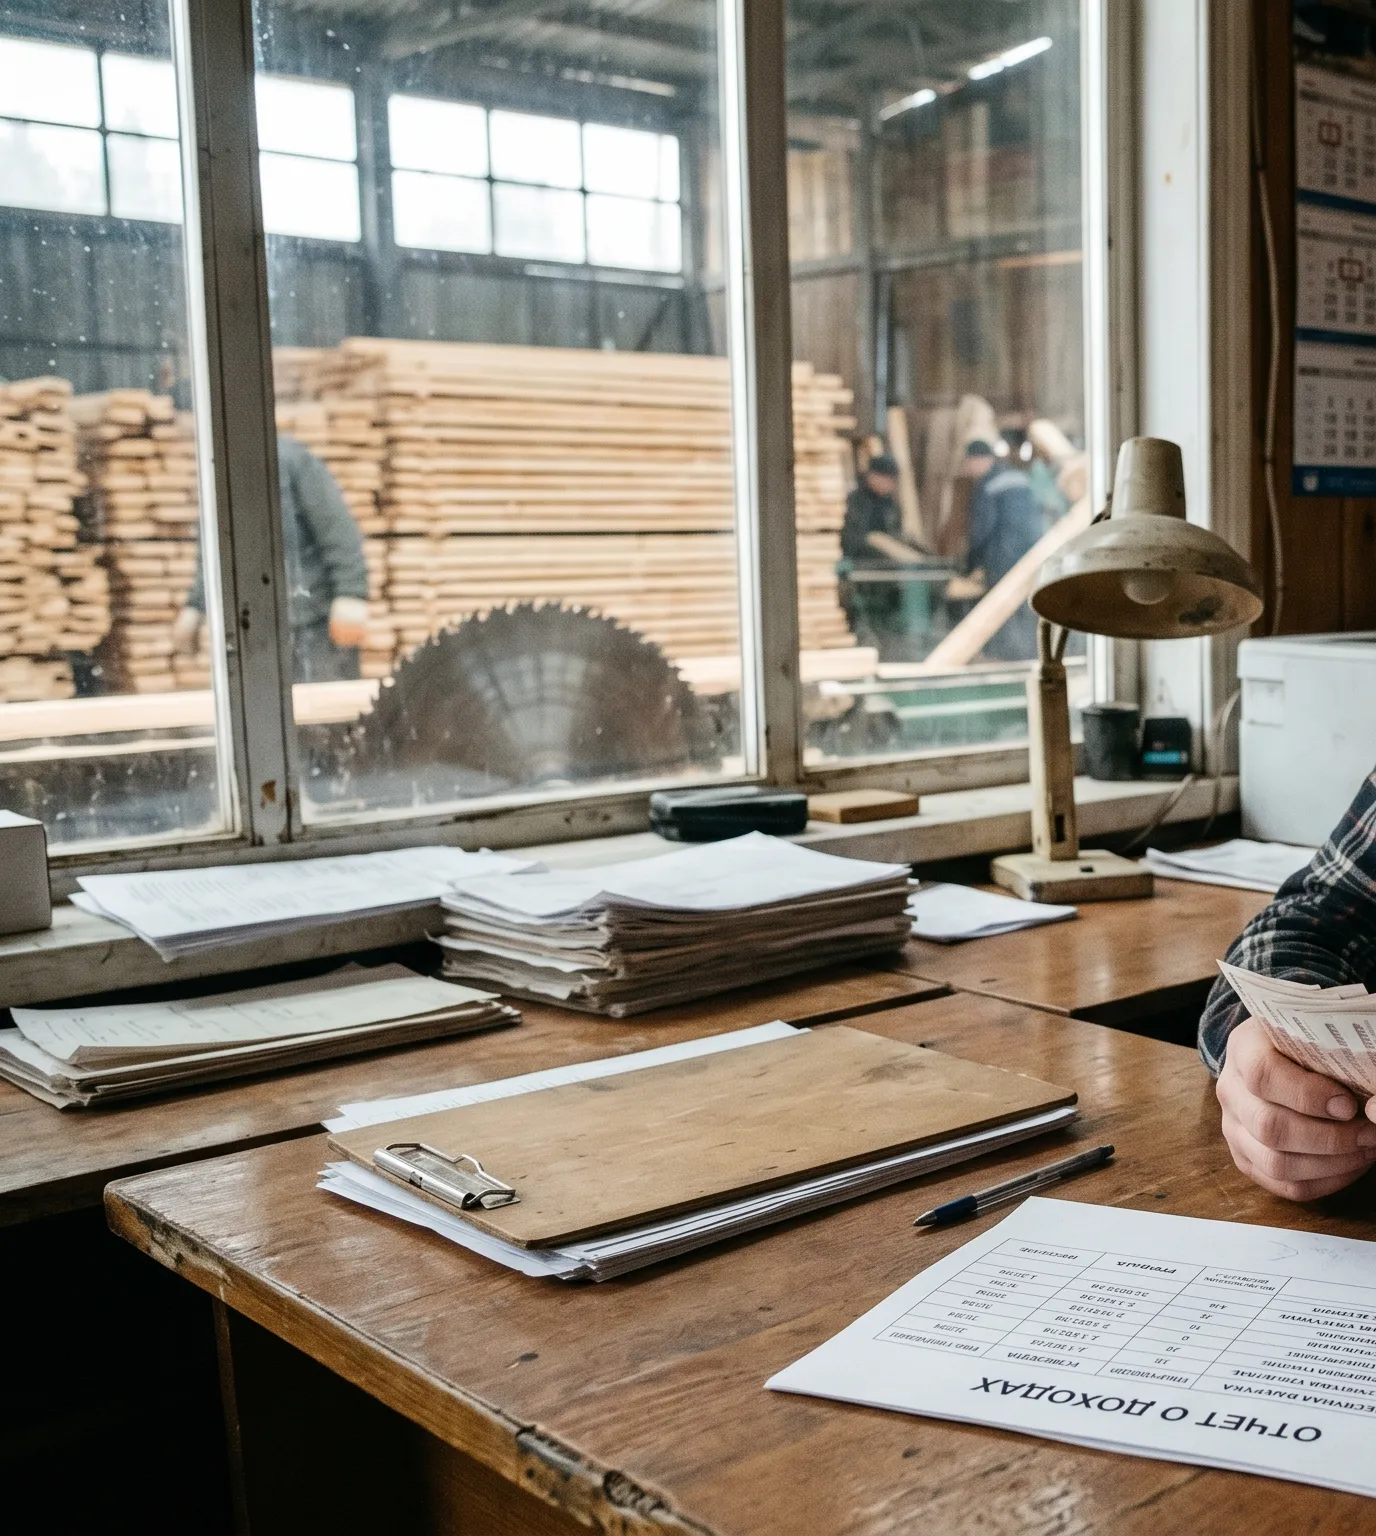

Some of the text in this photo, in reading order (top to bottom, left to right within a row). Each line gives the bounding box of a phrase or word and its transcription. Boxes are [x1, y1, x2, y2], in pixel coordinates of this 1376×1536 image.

[970, 1377, 1322, 1442] ОТЧЕТ О ДОХОДАХ
